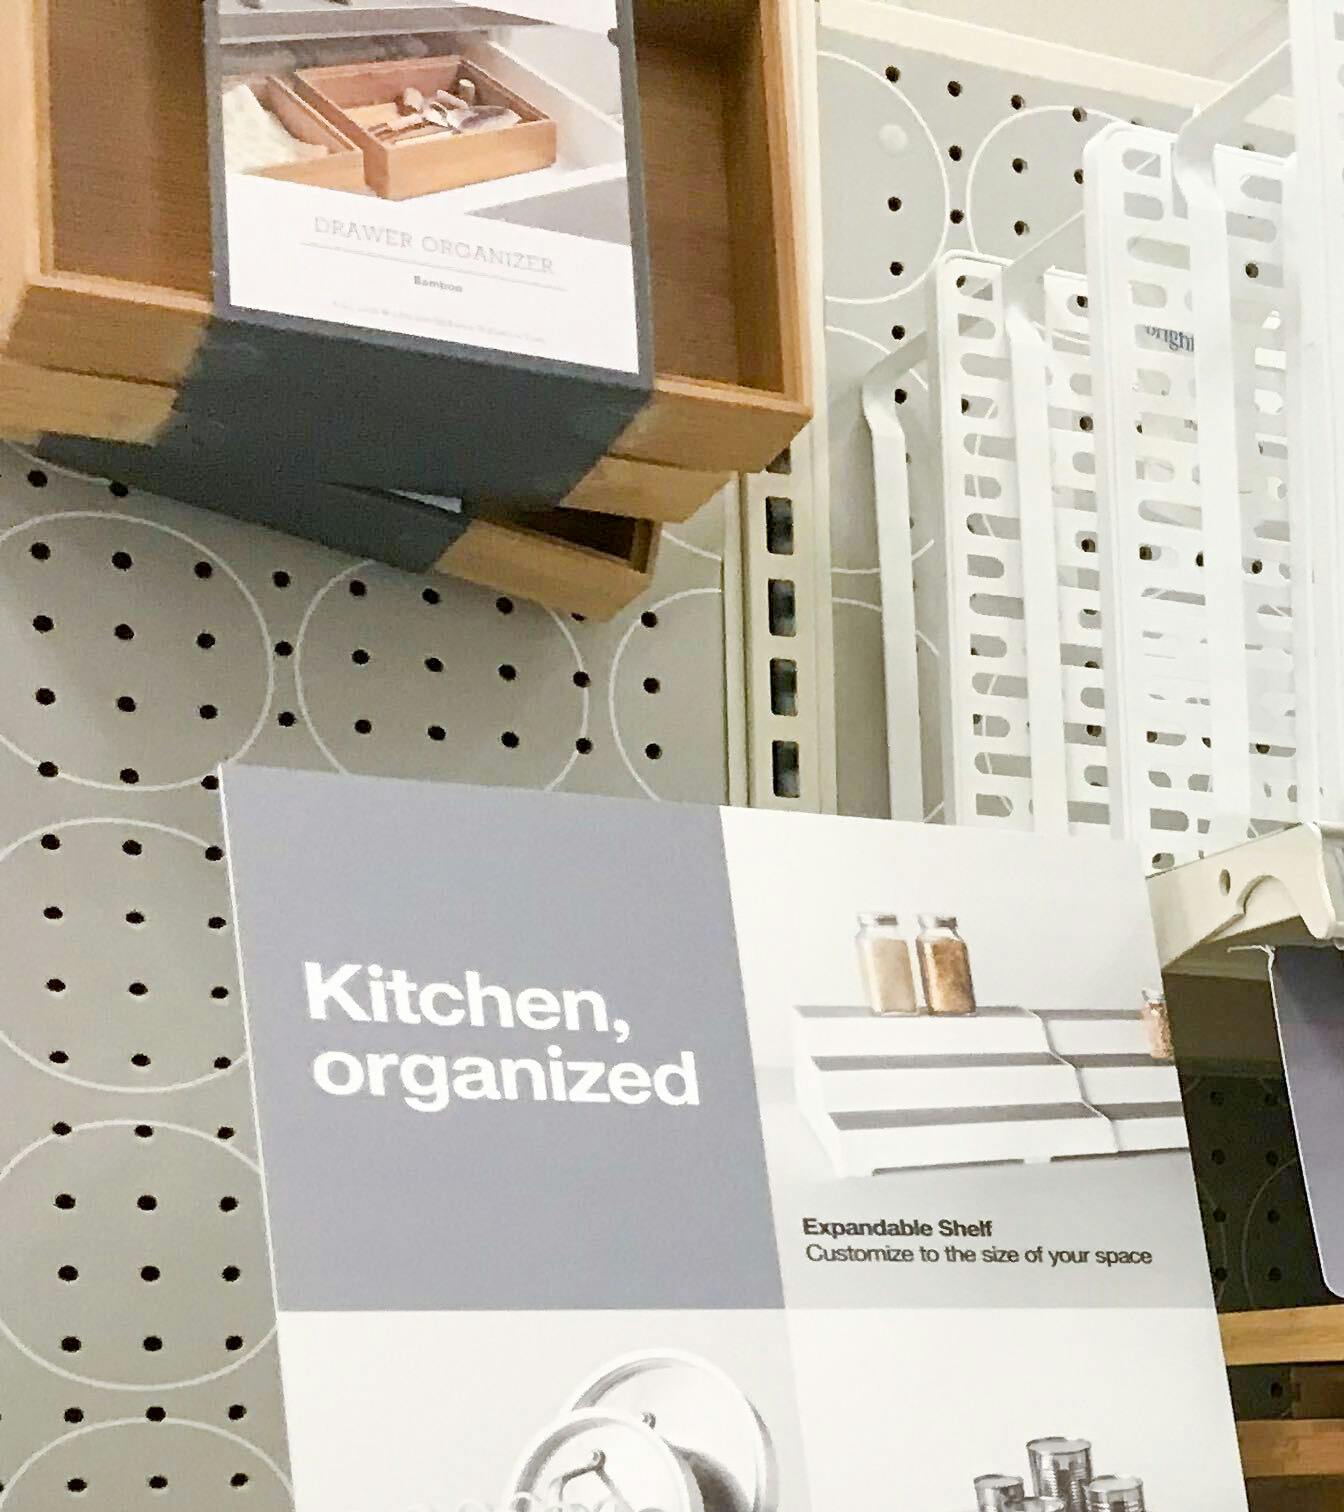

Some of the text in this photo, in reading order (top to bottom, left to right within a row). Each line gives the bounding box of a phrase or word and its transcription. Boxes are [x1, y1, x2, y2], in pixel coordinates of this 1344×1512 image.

[313, 216, 554, 274] DRAWER ORGANIZER
[413, 275, 463, 294] Bamboo
[304, 961, 631, 1043] Kitchen,
[312, 1044, 700, 1113] organized
[802, 1217, 993, 1240] Expandable Shelf
[805, 1243, 1153, 1268] Customize to the size of your space
